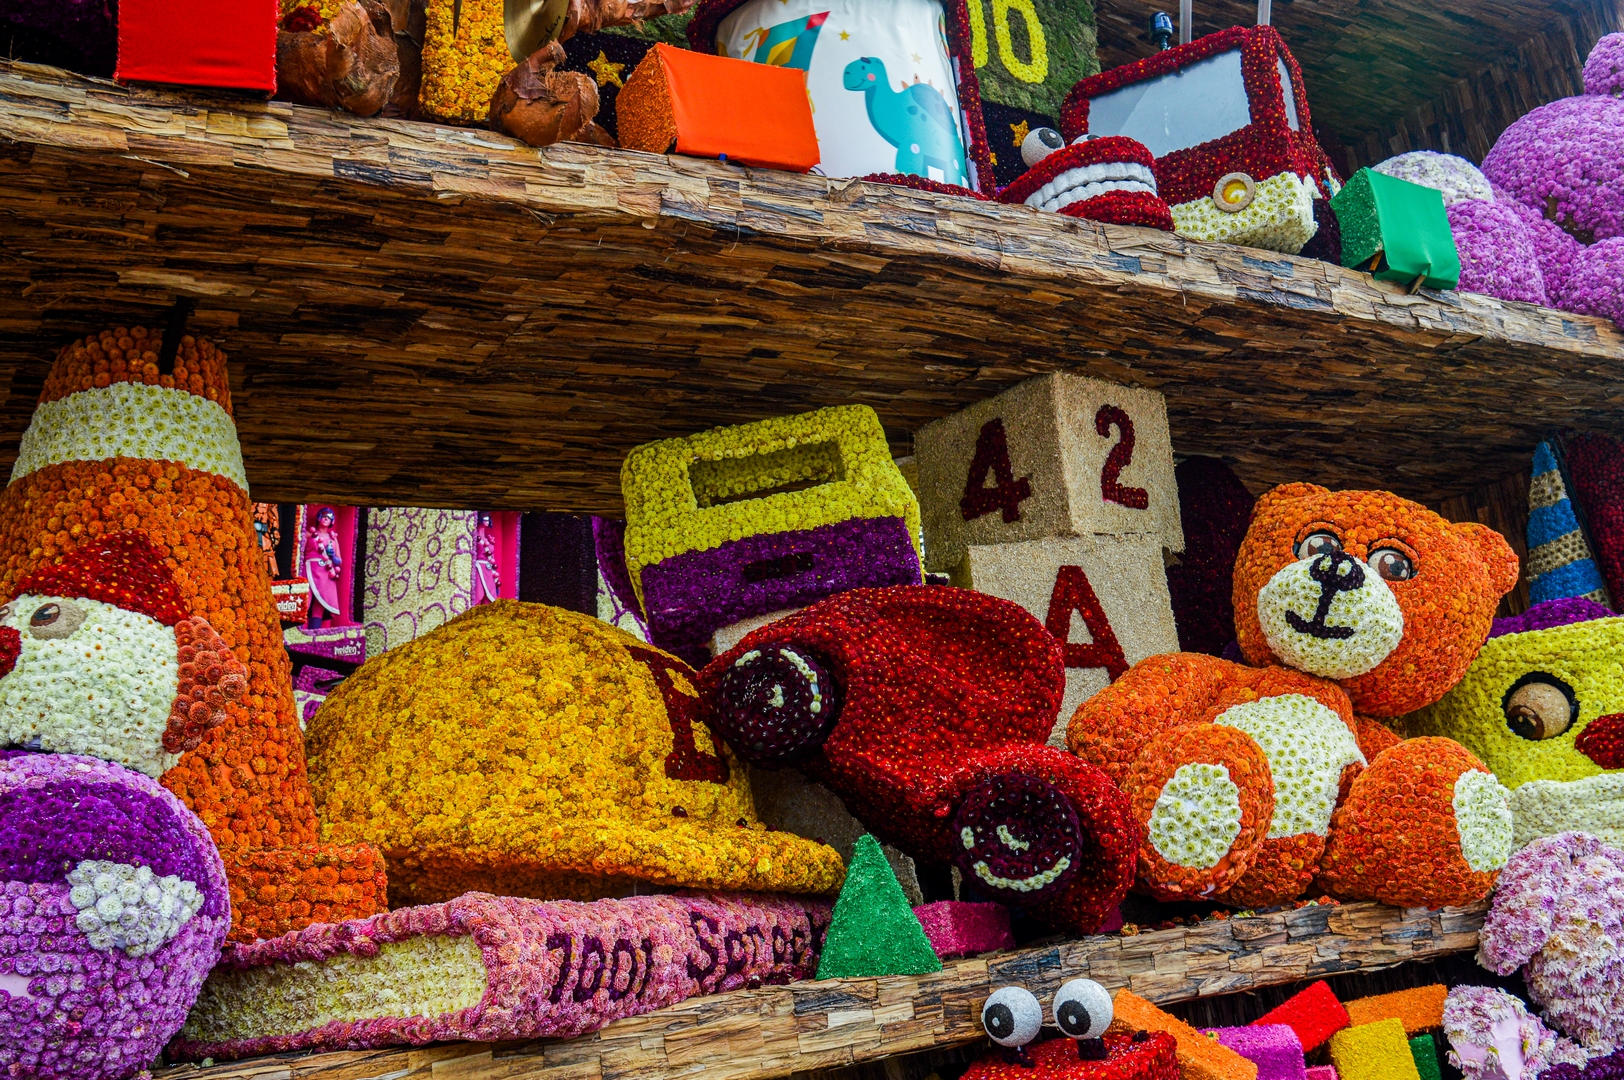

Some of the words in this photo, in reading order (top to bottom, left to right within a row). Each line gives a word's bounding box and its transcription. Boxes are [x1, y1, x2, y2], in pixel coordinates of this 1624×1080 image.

[960, 417, 1031, 523] 4
[1096, 404, 1149, 510] 2
[1045, 565, 1130, 682] A
